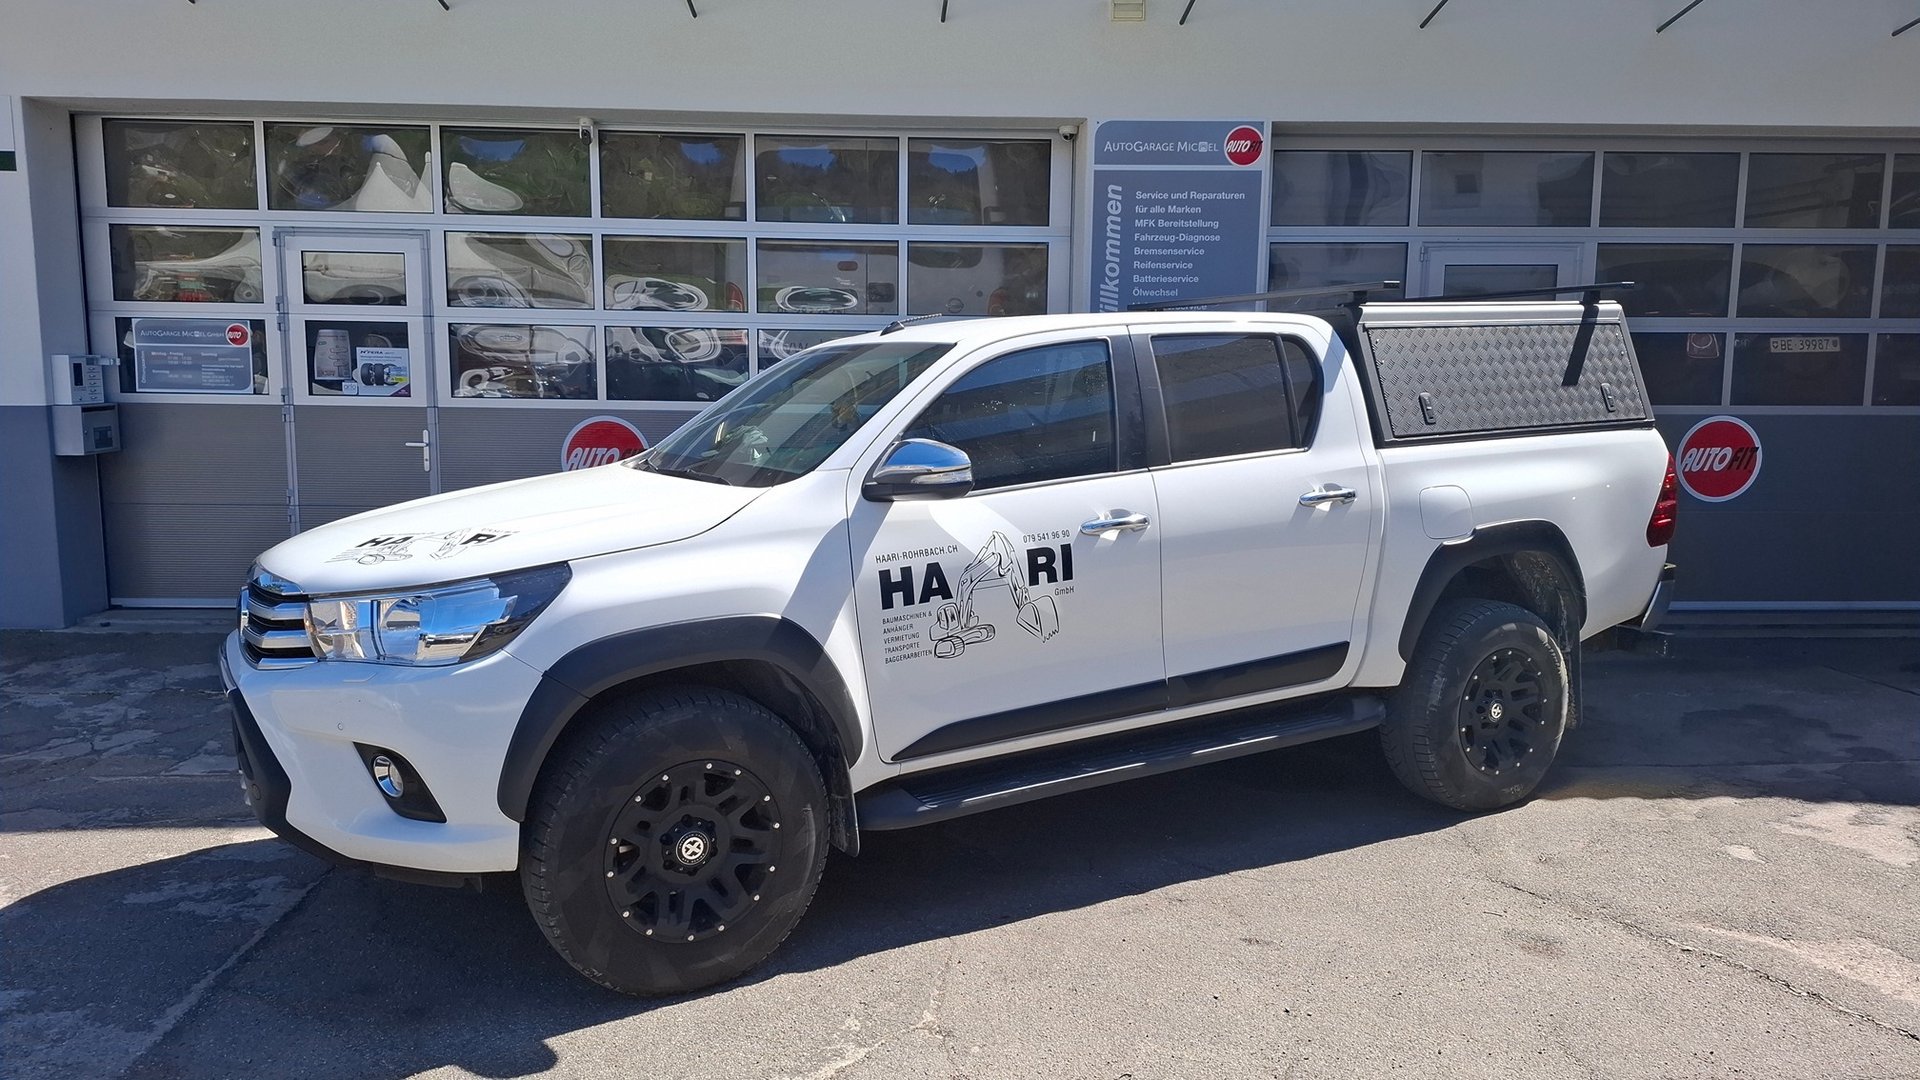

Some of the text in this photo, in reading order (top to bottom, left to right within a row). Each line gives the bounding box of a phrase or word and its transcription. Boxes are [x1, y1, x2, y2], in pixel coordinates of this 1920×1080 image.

[1135, 191, 1245, 201] Service und Reparaturen
[1135, 205, 1201, 213] für alle Marken
[1135, 219, 1219, 229] MFK Bereitstellung
[1134, 233, 1221, 243] Fahrzeug-Diagnose
[1099, 184, 1122, 312] illkommen
[1134, 247, 1205, 255] Bremsenservice
[1133, 261, 1193, 269] Reifenservice
[1133, 275, 1199, 283] Batterieservice
[1132, 288, 1178, 297] Ölwechsel
[1780, 338, 1830, 350] BE 39987
[1681, 446, 1759, 473] AUTOFIT
[1022, 529, 1070, 543] 079 541 96 90
[876, 545, 958, 563] HAARI-ROHRBACH.CH
[1054, 586, 1075, 595] GmbH
[882, 612, 926, 625] BAUMASCHINEN
[883, 632, 920, 644] VERMIETUNG
[884, 642, 920, 654] TRANSPORTE
[885, 650, 933, 664] BAGGERARBEITEN
